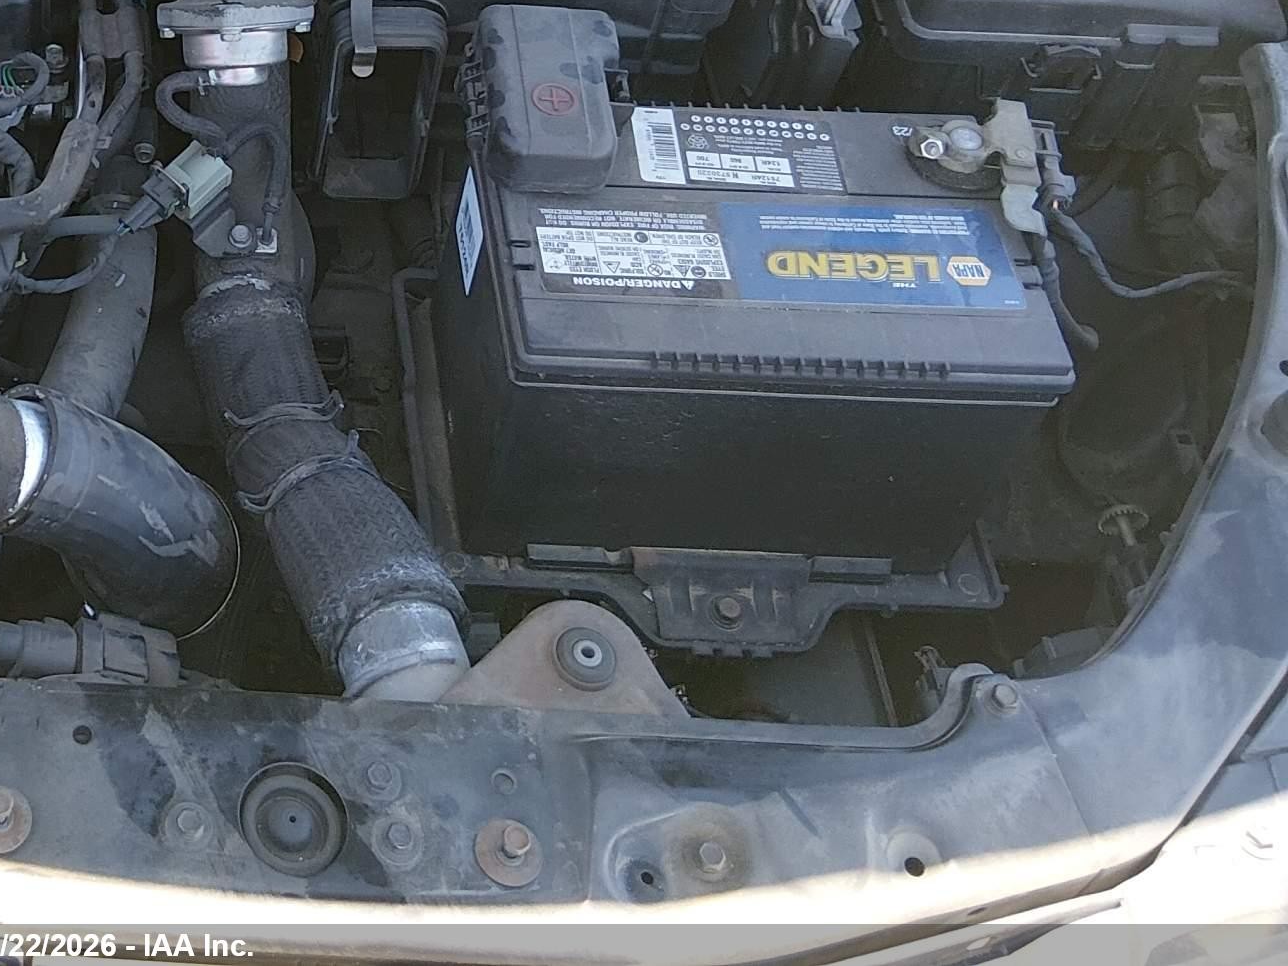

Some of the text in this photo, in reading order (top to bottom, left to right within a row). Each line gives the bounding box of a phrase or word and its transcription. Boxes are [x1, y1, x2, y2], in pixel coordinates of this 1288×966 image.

[766, 251, 943, 283] LEGEND
[952, 263, 985, 278] NAPA
[573, 276, 681, 289] DANGER/POISON
